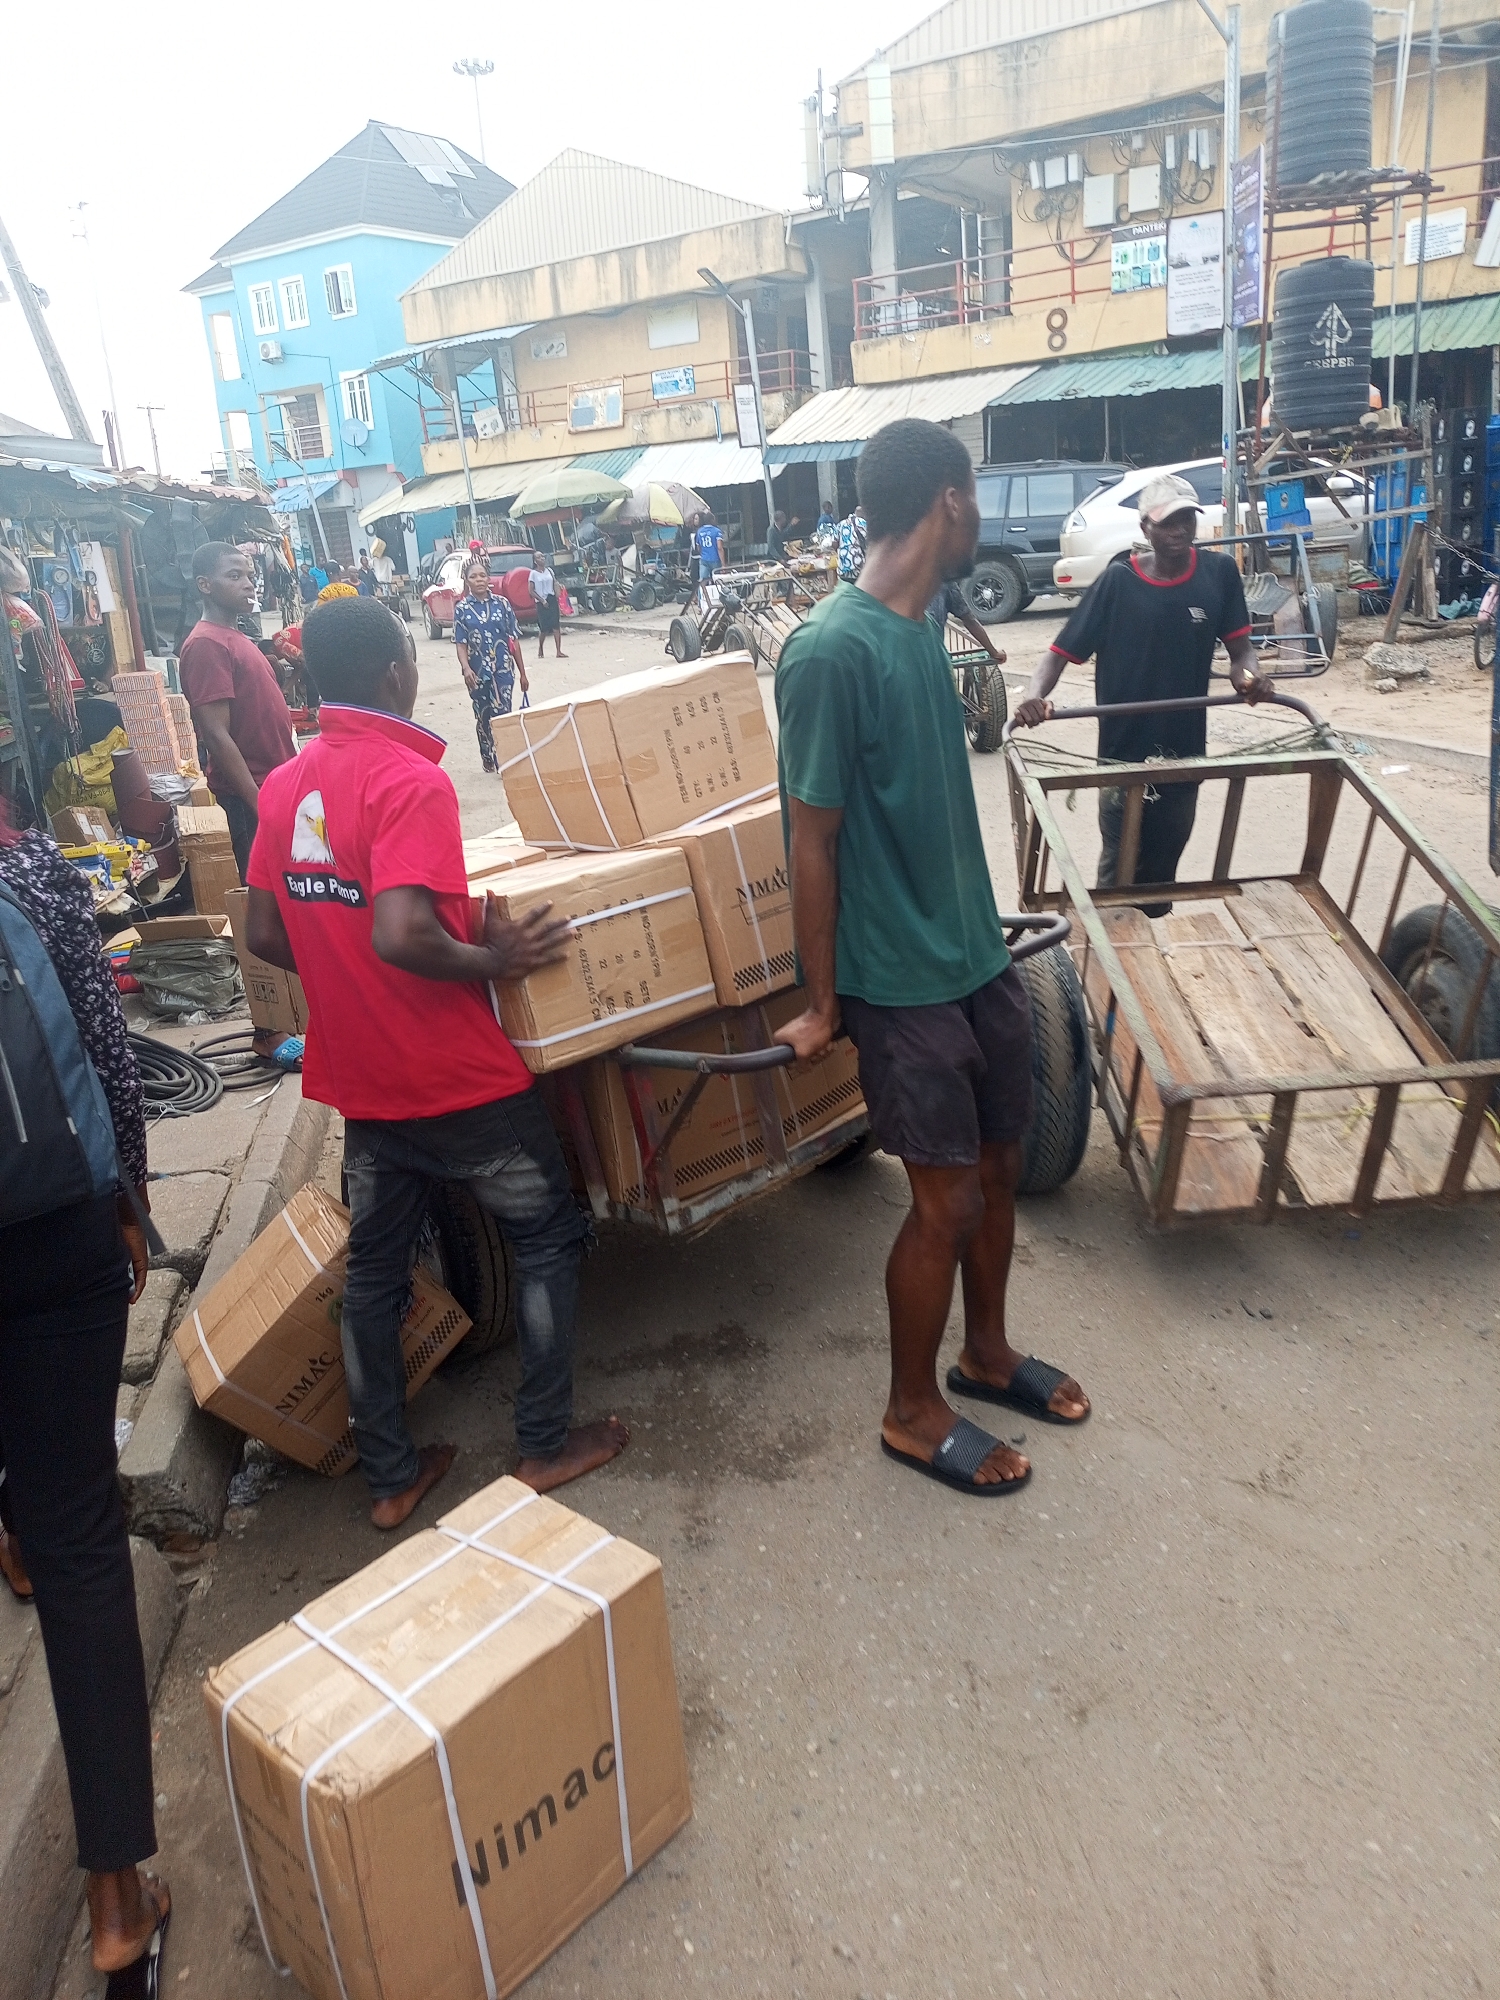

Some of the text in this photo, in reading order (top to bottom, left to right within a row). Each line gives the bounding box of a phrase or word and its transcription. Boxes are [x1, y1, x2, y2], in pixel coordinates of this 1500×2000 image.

[1046, 308, 1068, 352] 8
[701, 535, 712, 548] 18
[699, 696, 709, 714] KGS
[712, 691, 721, 704] CM
[672, 705, 684, 727] SETS
[686, 701, 696, 718] KGS
[287, 875, 360, 904] Eagle Pump
[636, 893, 648, 917] ITM
[599, 958, 608, 970] 22
[605, 995, 617, 1016] KGS
[639, 980, 651, 1004] SETS
[623, 990, 635, 1010] KGS
[315, 1286, 334, 1302] 1kg
[275, 1351, 336, 1417] NIMAC
[450, 1741, 618, 1909] Nimac
